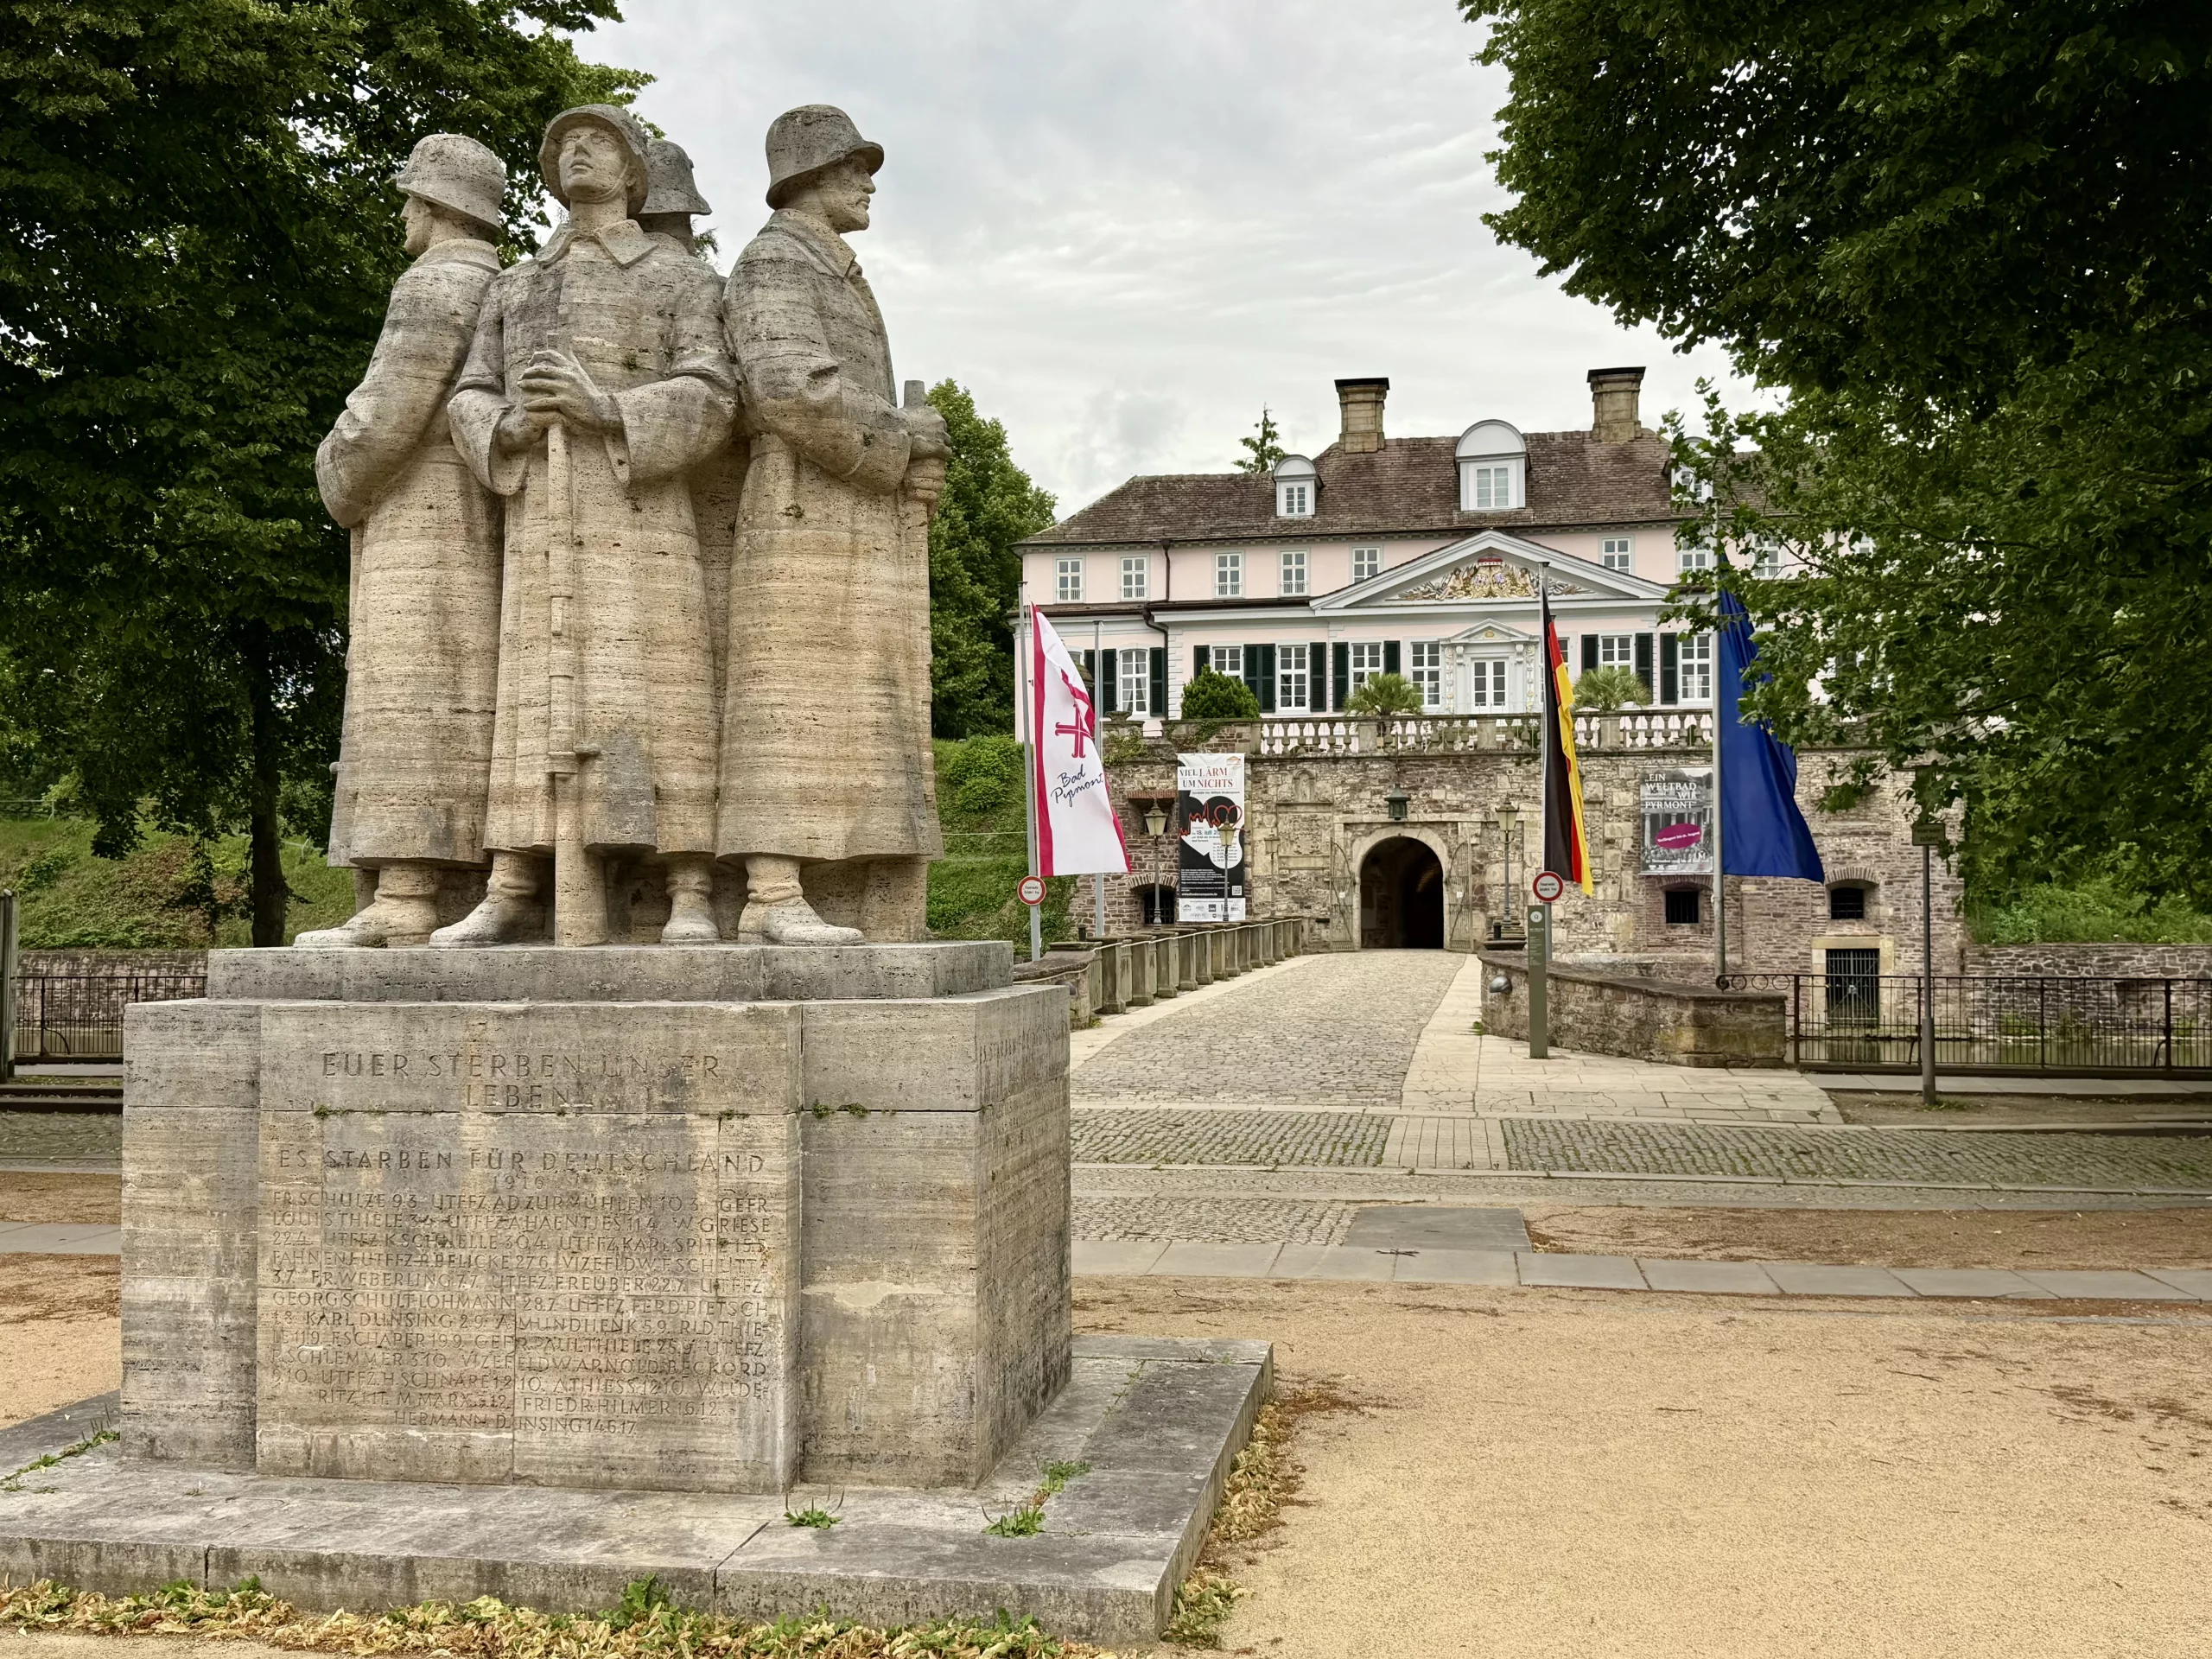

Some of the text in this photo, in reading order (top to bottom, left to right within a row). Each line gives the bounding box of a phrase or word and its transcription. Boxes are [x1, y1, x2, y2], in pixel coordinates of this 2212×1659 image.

[1057, 763, 1086, 788] Bad
[1199, 766, 1228, 777] LÄRM
[1051, 772, 1104, 808] Pyrmont
[1183, 779, 1233, 788] UM NICHTS
[1645, 782, 1697, 791] WELTBAD
[322, 1052, 719, 1078] EUER STERBEN UNSER
[467, 1084, 569, 1109] LEBEN
[280, 1147, 764, 1173] ES STARBEN FÜR DEUTSCHLAND
[493, 1175, 544, 1191] 1916
[299, 1192, 385, 1208] SCHULZE
[272, 1211, 333, 1227] LOUIS
[338, 1213, 403, 1229] THIELE
[525, 1216, 621, 1232] HAENTJES
[700, 1217, 770, 1234] GRIESE
[623, 1237, 671, 1253] KARL
[339, 1272, 451, 1288] WEBERLING
[272, 1290, 338, 1306] GEORG
[688, 1300, 767, 1318] PIETSCH
[306, 1310, 355, 1326] KARL
[360, 1313, 456, 1329] DUNSING
[518, 1318, 639, 1335] MUNDHENK
[343, 1332, 425, 1348] SCHAPER
[285, 1349, 404, 1366] SCHLEMMER
[319, 1389, 359, 1405] RITZ
[418, 1392, 473, 1409] MARX
[597, 1399, 670, 1415] HILMER
[394, 1410, 486, 1428] HERMANN
